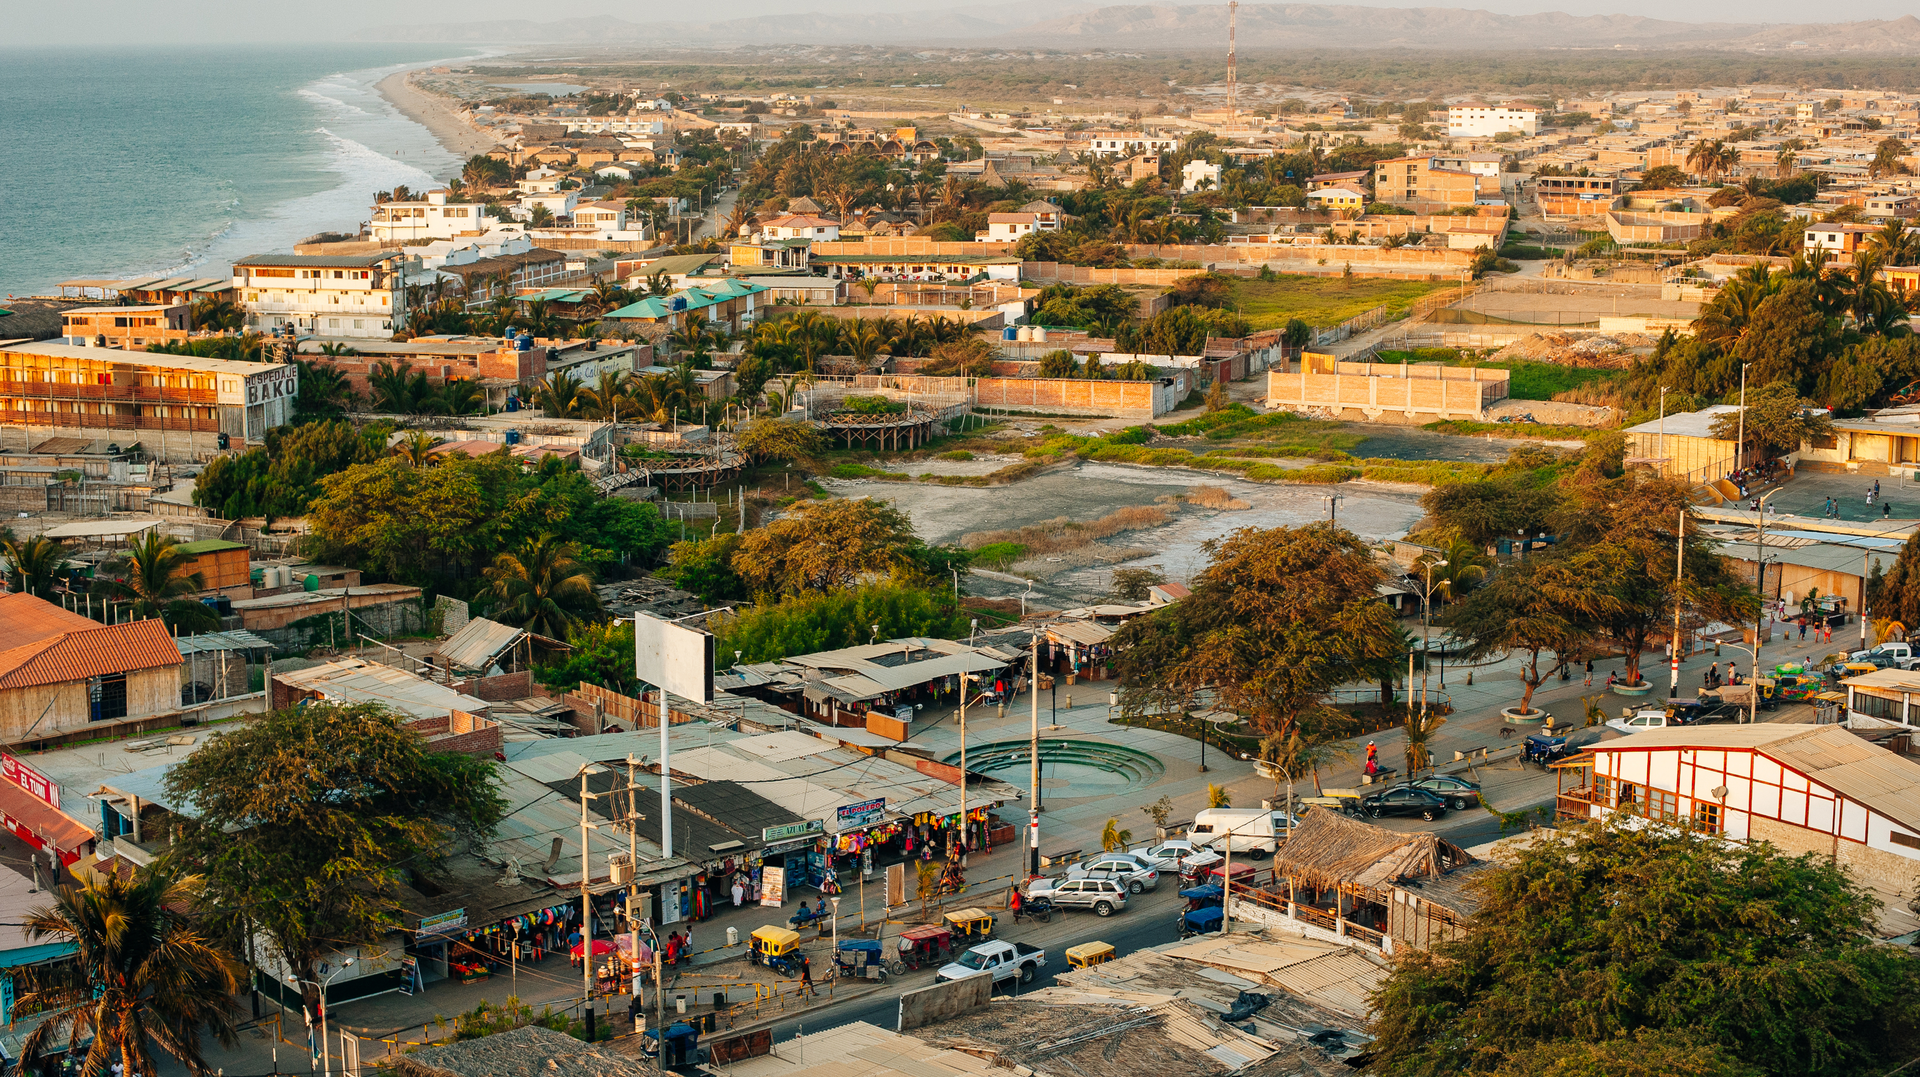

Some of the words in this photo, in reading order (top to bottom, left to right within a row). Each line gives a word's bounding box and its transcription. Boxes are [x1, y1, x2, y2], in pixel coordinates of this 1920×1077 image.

[245, 366, 297, 387] HOSPEDAJE
[248, 377, 295, 404] BAKO
[20, 772, 30, 790] EL
[29, 778, 46, 800] TUMI
